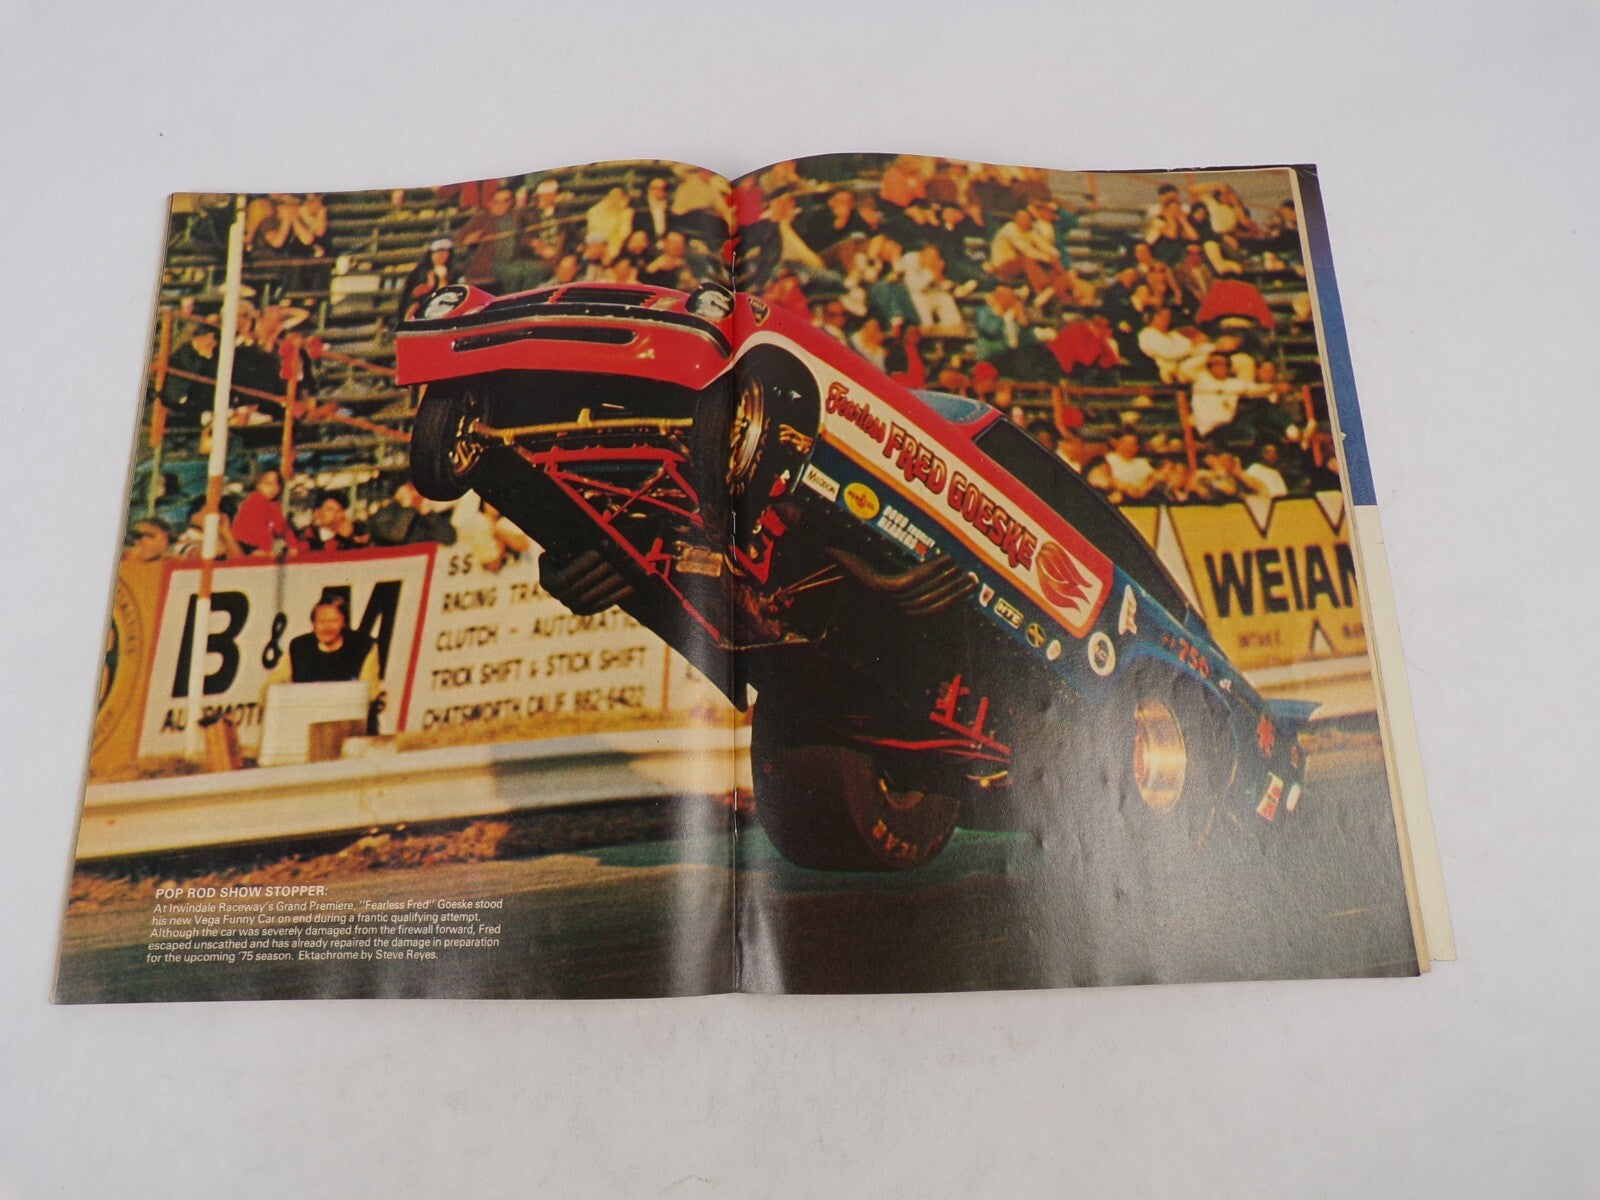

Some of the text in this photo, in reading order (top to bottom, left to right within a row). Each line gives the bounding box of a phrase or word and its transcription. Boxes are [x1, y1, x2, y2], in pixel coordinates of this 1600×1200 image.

[882, 421, 948, 495] FRED
[947, 470, 1039, 571] GOESKE
[442, 585, 498, 613] RACING
[435, 624, 499, 652] CLUTCH
[431, 665, 474, 691] TRICK
[479, 658, 523, 685] SHIFT
[546, 652, 591, 677] STICK
[599, 645, 647, 672] SHIFT
[156, 886, 328, 899] POP ROD SHOW STOPPER:
[154, 904, 167, 913] At
[169, 902, 216, 913] Irwindale
[276, 901, 306, 911] Grand
[310, 900, 356, 912] Premiere,
[438, 899, 472, 909] Goeske
[475, 899, 503, 909] stood
[152, 912, 481, 926] his new Vega Funny Car on end during a frantic qualifying attempt.
[150, 928, 199, 939] Although
[202, 927, 218, 936] the
[239, 928, 260, 936] was
[262, 926, 302, 937] severely
[305, 926, 351, 937] damaged
[354, 925, 377, 935] from
[380, 925, 396, 934] the
[398, 924, 433, 934] firewall
[436, 924, 475, 935] forward,
[479, 924, 501, 934] Fred
[148, 937, 500, 952] escaped unscathed and has already repaired the damage in preparation
[146, 953, 161, 963] for
[164, 952, 182, 962] the
[184, 952, 235, 964] upcoming
[256, 952, 294, 961] season.
[298, 950, 359, 961] Ektachrome
[361, 950, 373, 961] by
[376, 950, 404, 960] Steve
[406, 950, 438, 961] Reyes.
